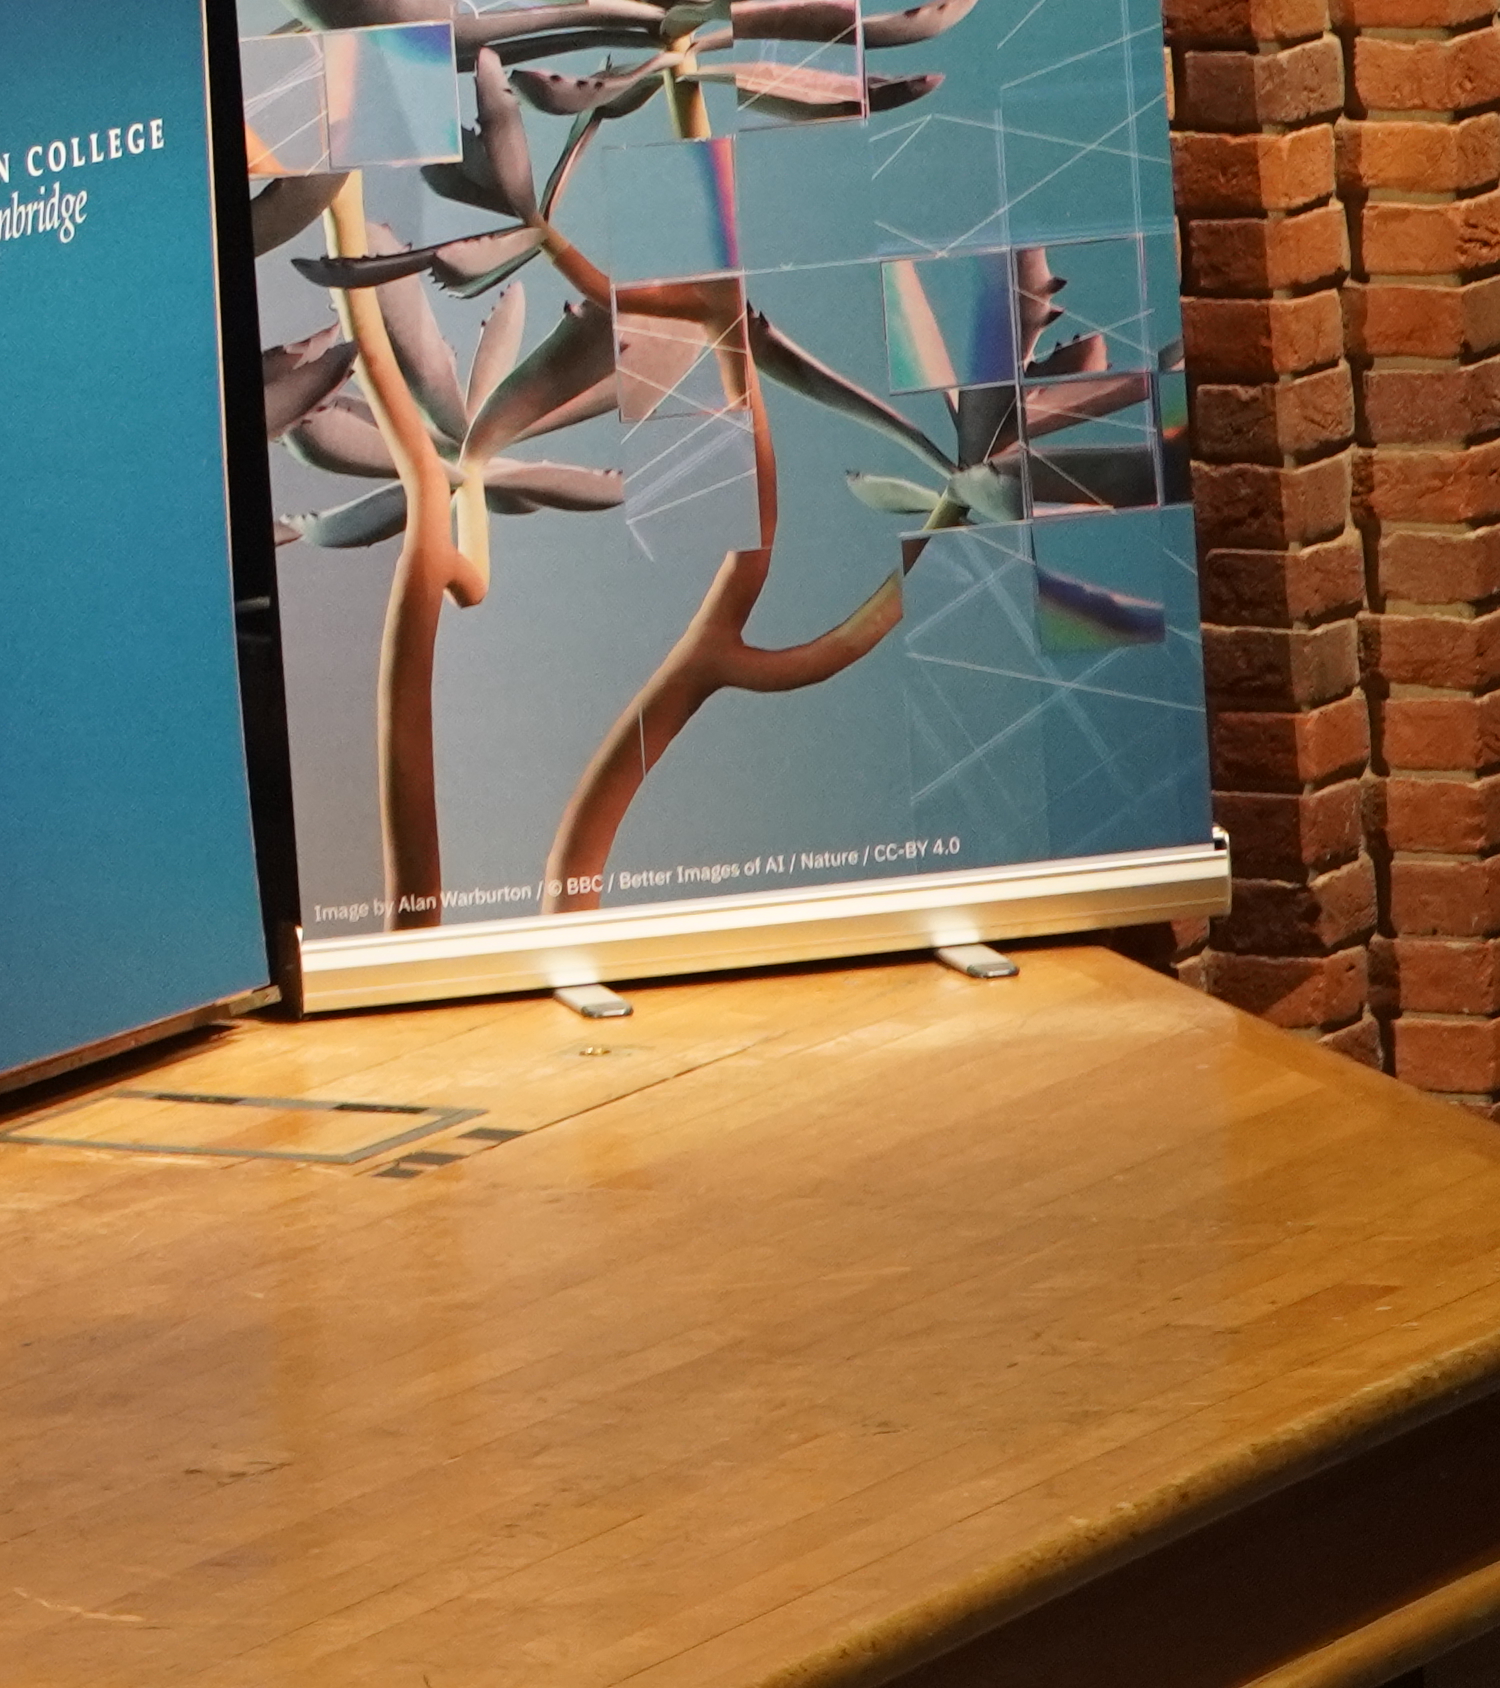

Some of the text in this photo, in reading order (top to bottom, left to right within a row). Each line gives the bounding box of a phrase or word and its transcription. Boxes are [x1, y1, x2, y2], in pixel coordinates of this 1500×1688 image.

[26, 118, 165, 177] COLLEGE
[313, 902, 369, 923] Image
[373, 898, 395, 918] by
[398, 894, 437, 914] Alan
[440, 881, 532, 909] Warburton
[566, 875, 604, 896] BBC
[619, 867, 672, 890] Better
[676, 861, 740, 885] Images
[743, 858, 762, 878] of
[765, 854, 786, 874] AI
[800, 848, 859, 871] Nature
[874, 839, 928, 863] CC-BY
[932, 835, 961, 856] 4.0
